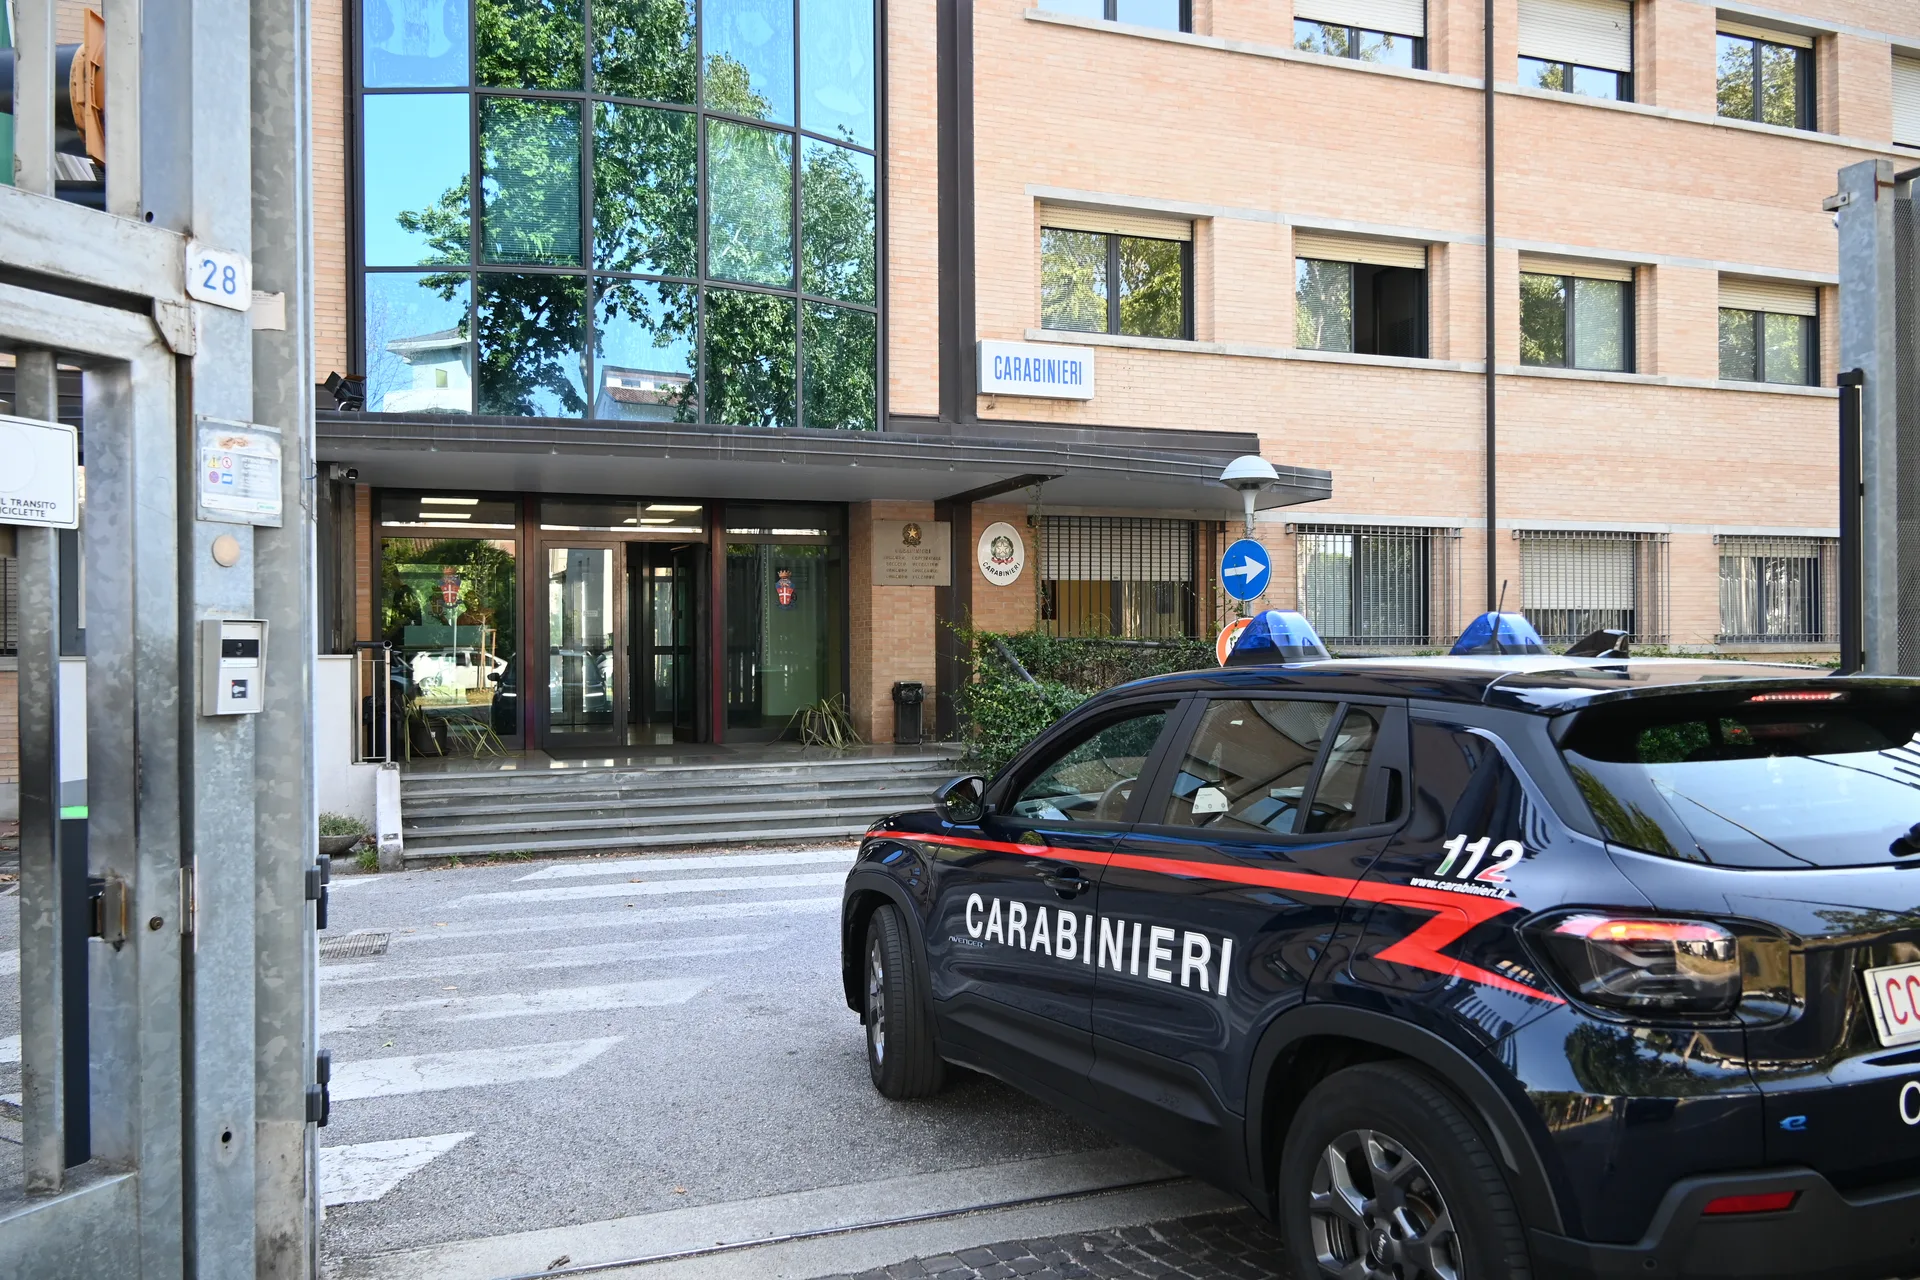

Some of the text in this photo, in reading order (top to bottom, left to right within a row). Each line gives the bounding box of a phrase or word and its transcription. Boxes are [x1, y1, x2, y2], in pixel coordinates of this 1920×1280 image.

[203, 259, 236, 295] 28
[993, 354, 1082, 386] CARABINIERI
[10, 498, 56, 509] TRANSITO
[982, 560, 1021, 577] CARABINIERI
[1434, 834, 1524, 884] 112
[1410, 877, 1510, 899] www.carabinieri.it
[948, 935, 984, 949] AVENGER
[965, 892, 1233, 997] CARABINIERI
